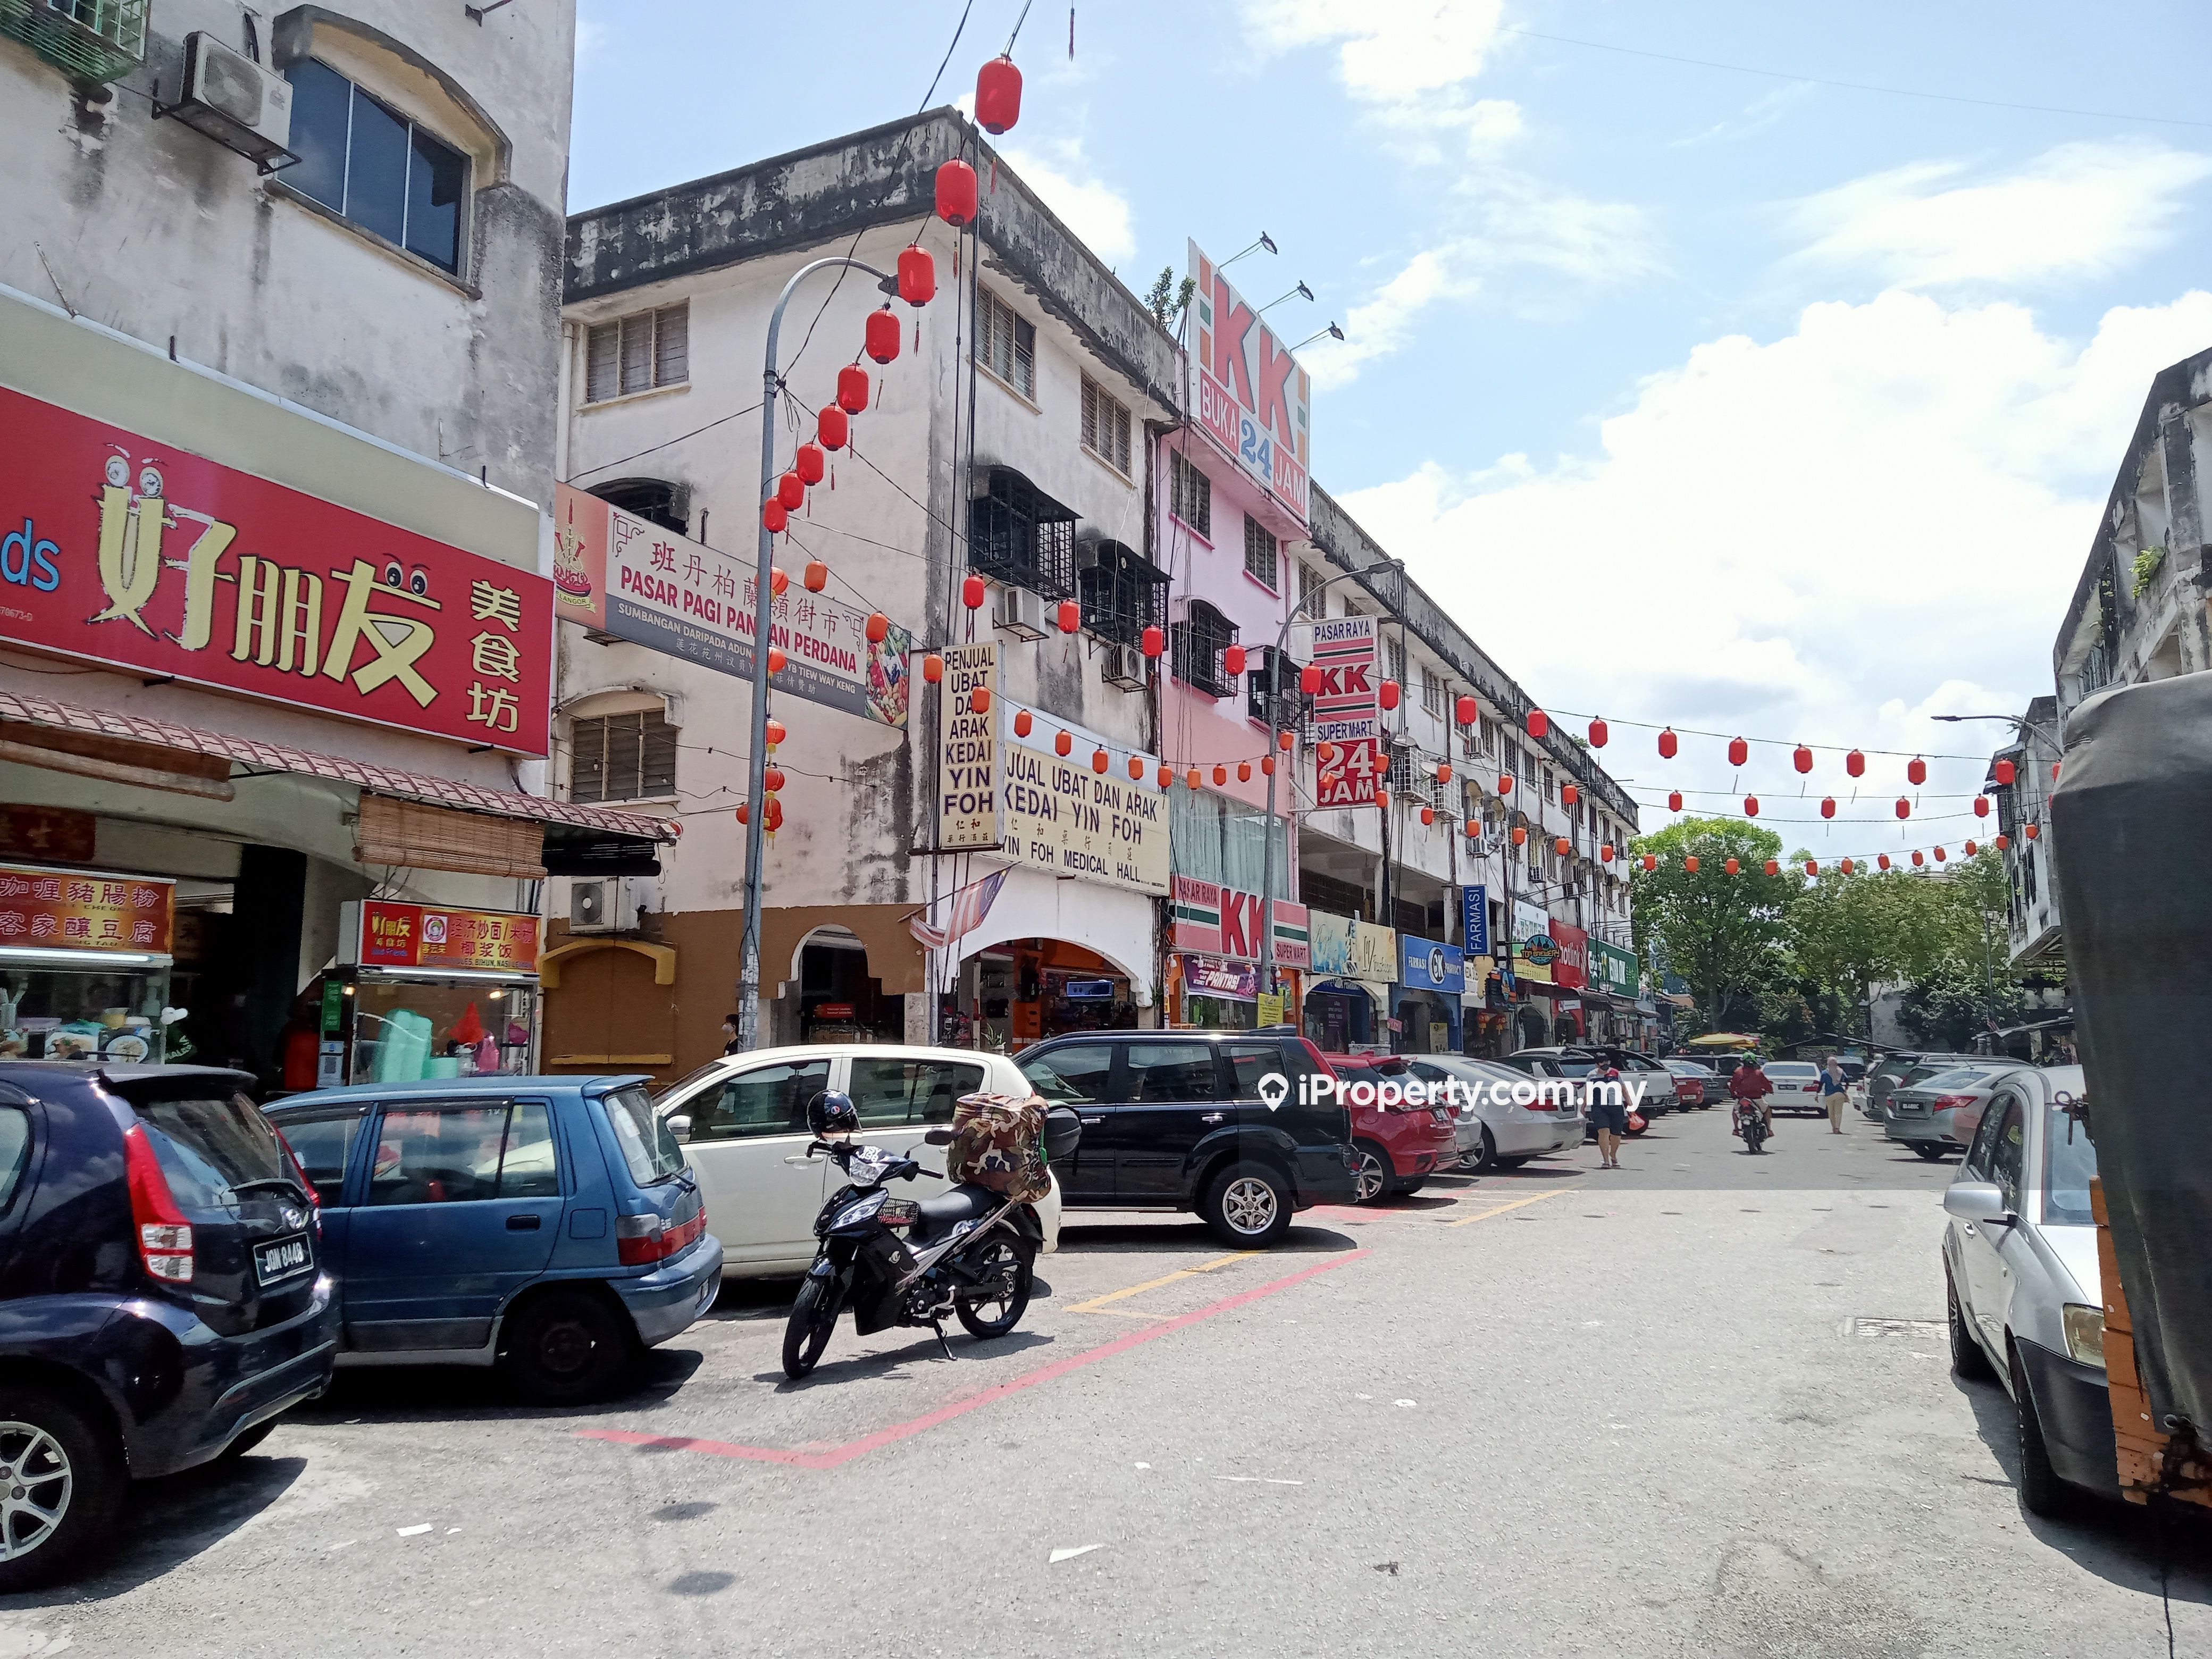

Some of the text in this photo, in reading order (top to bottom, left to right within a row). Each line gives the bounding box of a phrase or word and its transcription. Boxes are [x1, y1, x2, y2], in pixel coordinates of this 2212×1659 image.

[1213, 273, 1295, 454] KK
[1202, 378, 1305, 509] BUKA 24 JAM
[87, 481, 442, 708] 好朋友
[556, 589, 587, 605] ELANGOR
[621, 565, 678, 608] PASAR
[683, 590, 720, 625] PAGI
[727, 606, 790, 650] PANAN
[794, 631, 857, 674] PERDANA
[1315, 620, 1371, 642] PASAR RAYA
[465, 580, 521, 733] 美食坊
[618, 602, 856, 694] SUMBANGAN DARIPADA ADUN YB TIEW WAY KENG
[945, 647, 994, 671] PENJUAL
[951, 670, 988, 693] UBAT
[1317, 664, 1371, 697] KK
[955, 695, 984, 716] DA
[950, 716, 989, 740] ARAK
[1318, 720, 1373, 741] SUPER MART
[945, 739, 992, 765] KEDAI
[1318, 742, 1374, 781] 24
[948, 765, 991, 790] YIN
[1004, 749, 1158, 823] JUAL UBAT DAN ARAK
[1319, 778, 1376, 803] JAM
[943, 791, 994, 816] FOH
[956, 818, 981, 831] 仁和
[1070, 800, 1100, 834] YIN
[1112, 814, 1142, 845] FOH
[1030, 841, 1054, 864] FOH
[1063, 849, 1109, 876] MEDICAL
[1117, 861, 1141, 883] HALL
[1202, 885, 1218, 906] RAYA
[1221, 887, 1272, 960] KK
[1470, 888, 1481, 951] FARMASI
[1276, 943, 1293, 959] SUPER
[1408, 956, 1427, 970] FARMASI
[1559, 939, 1580, 968] hotlink
